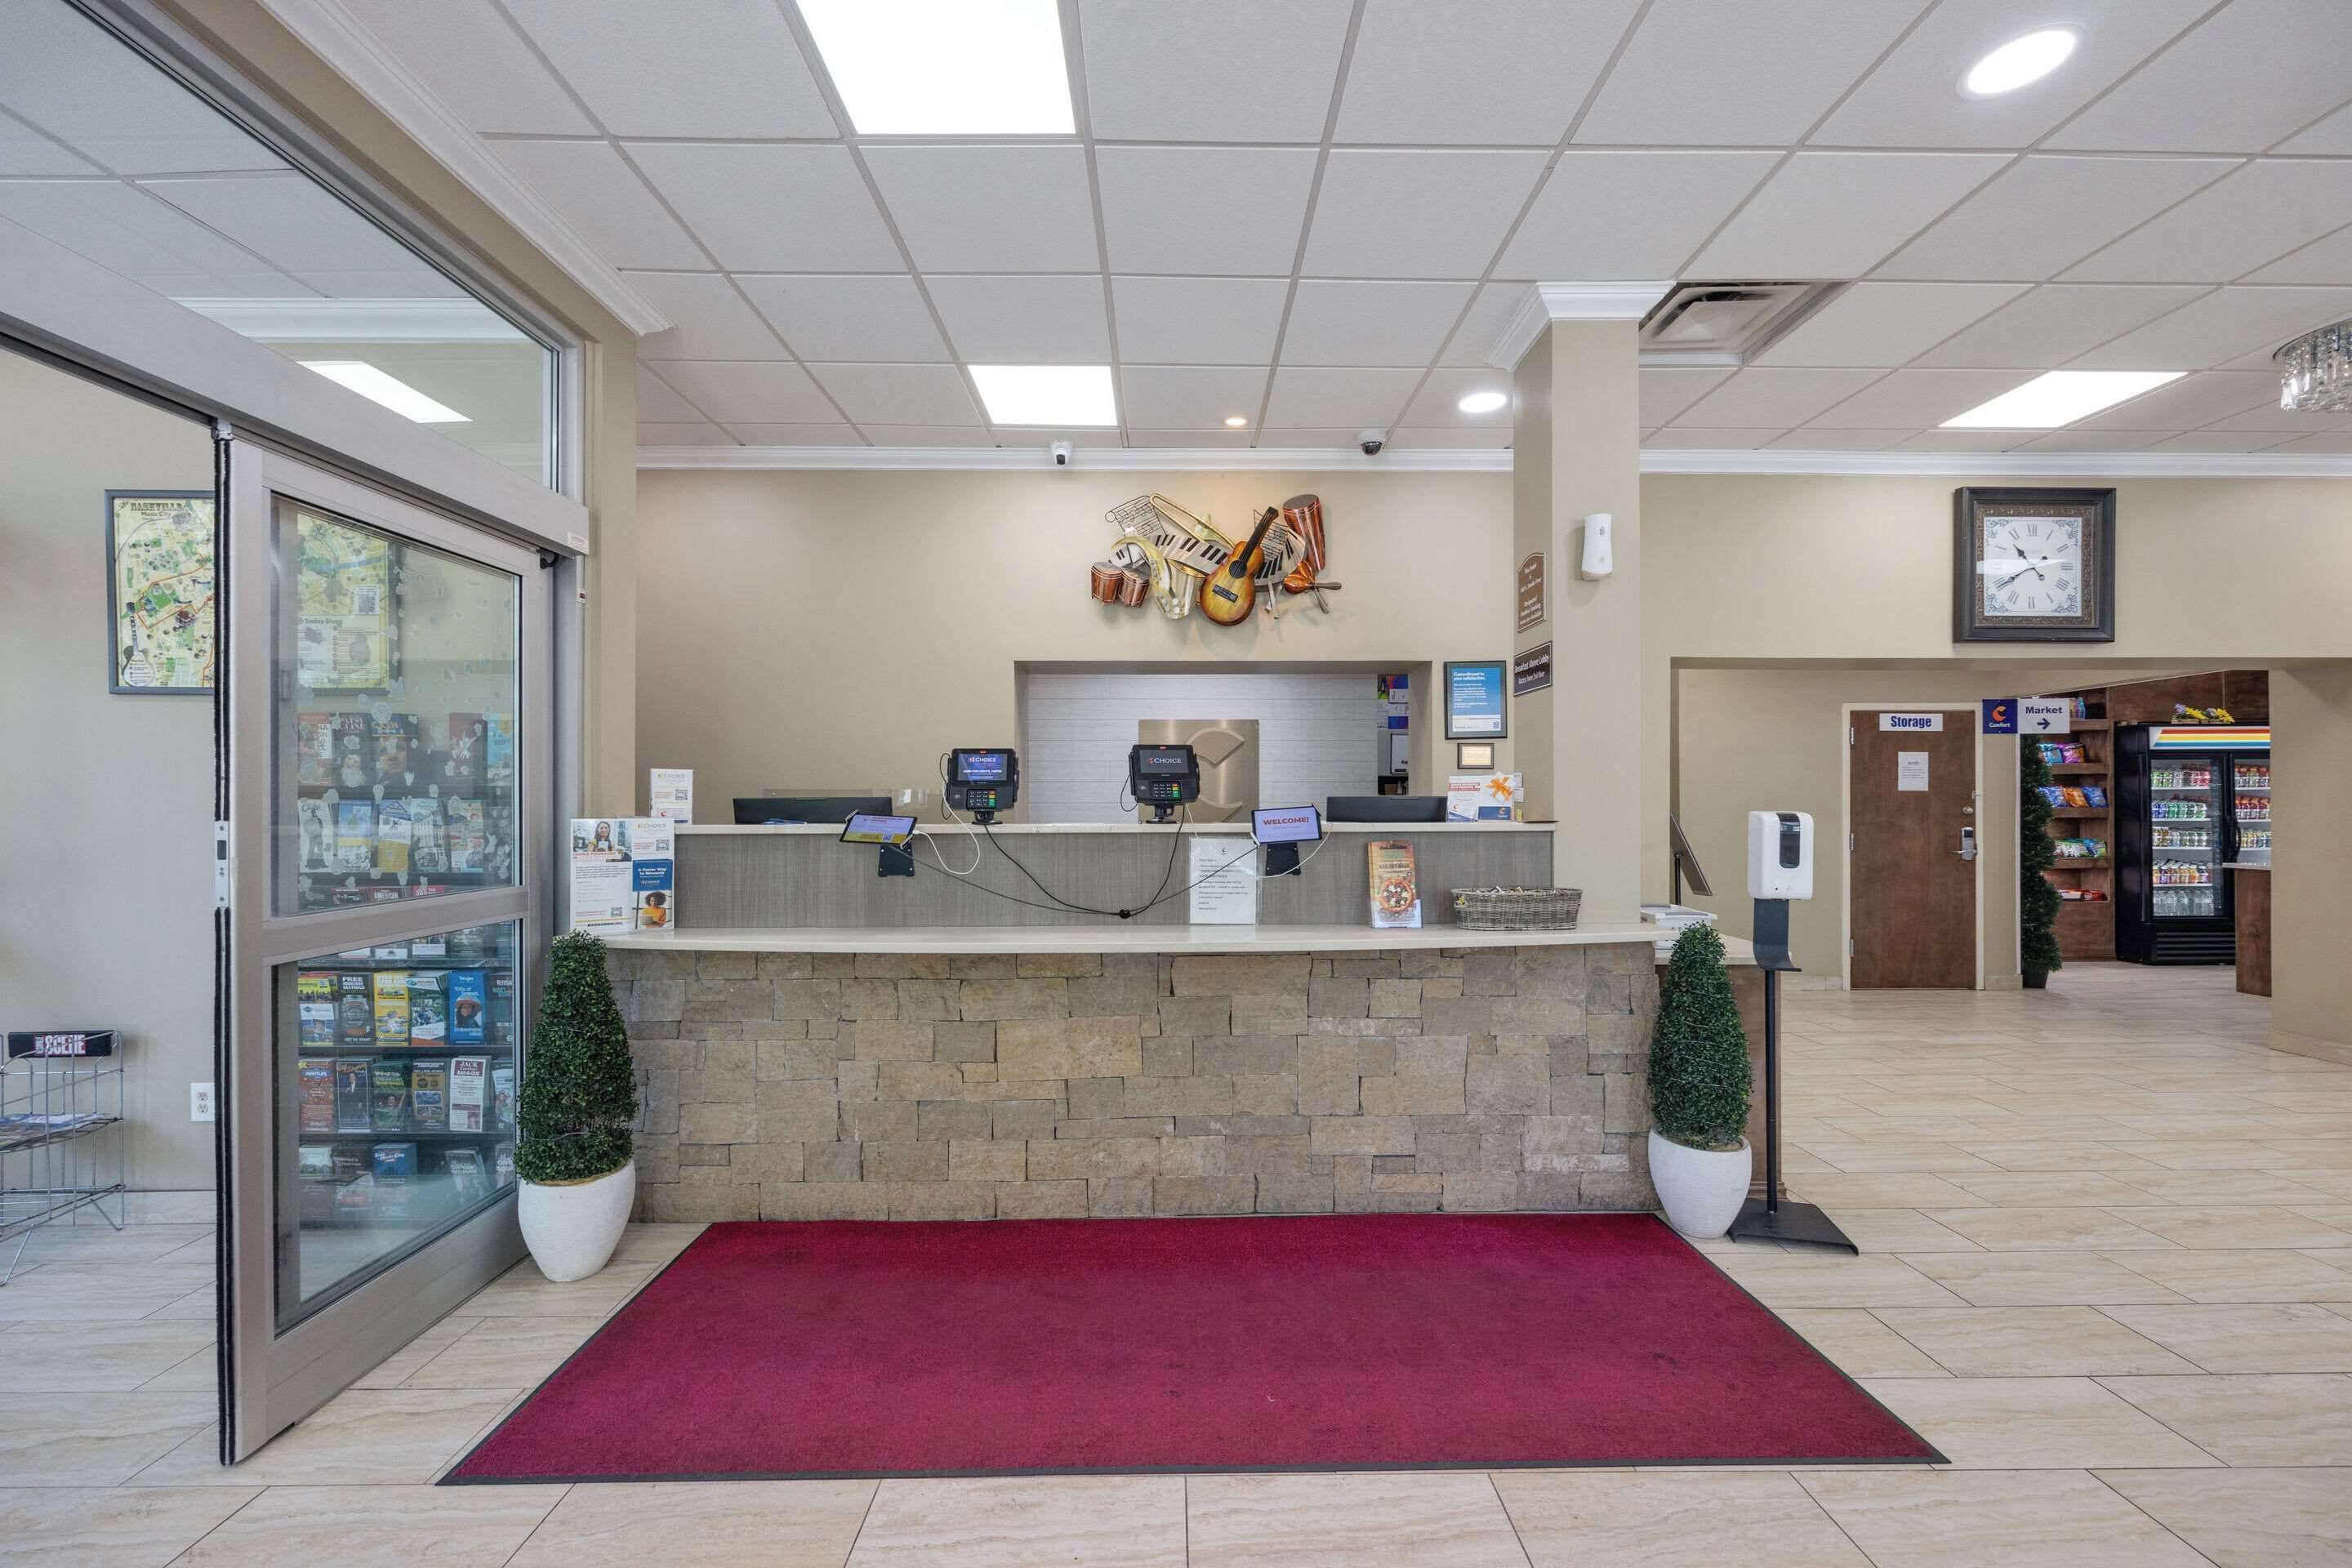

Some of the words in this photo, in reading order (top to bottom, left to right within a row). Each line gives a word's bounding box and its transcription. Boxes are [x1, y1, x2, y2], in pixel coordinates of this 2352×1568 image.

[1529, 658, 1539, 667] Above
[1539, 653, 1550, 665] Lobby
[1891, 715, 1932, 728] Storage
[1263, 817, 1309, 826] WELCOME!
